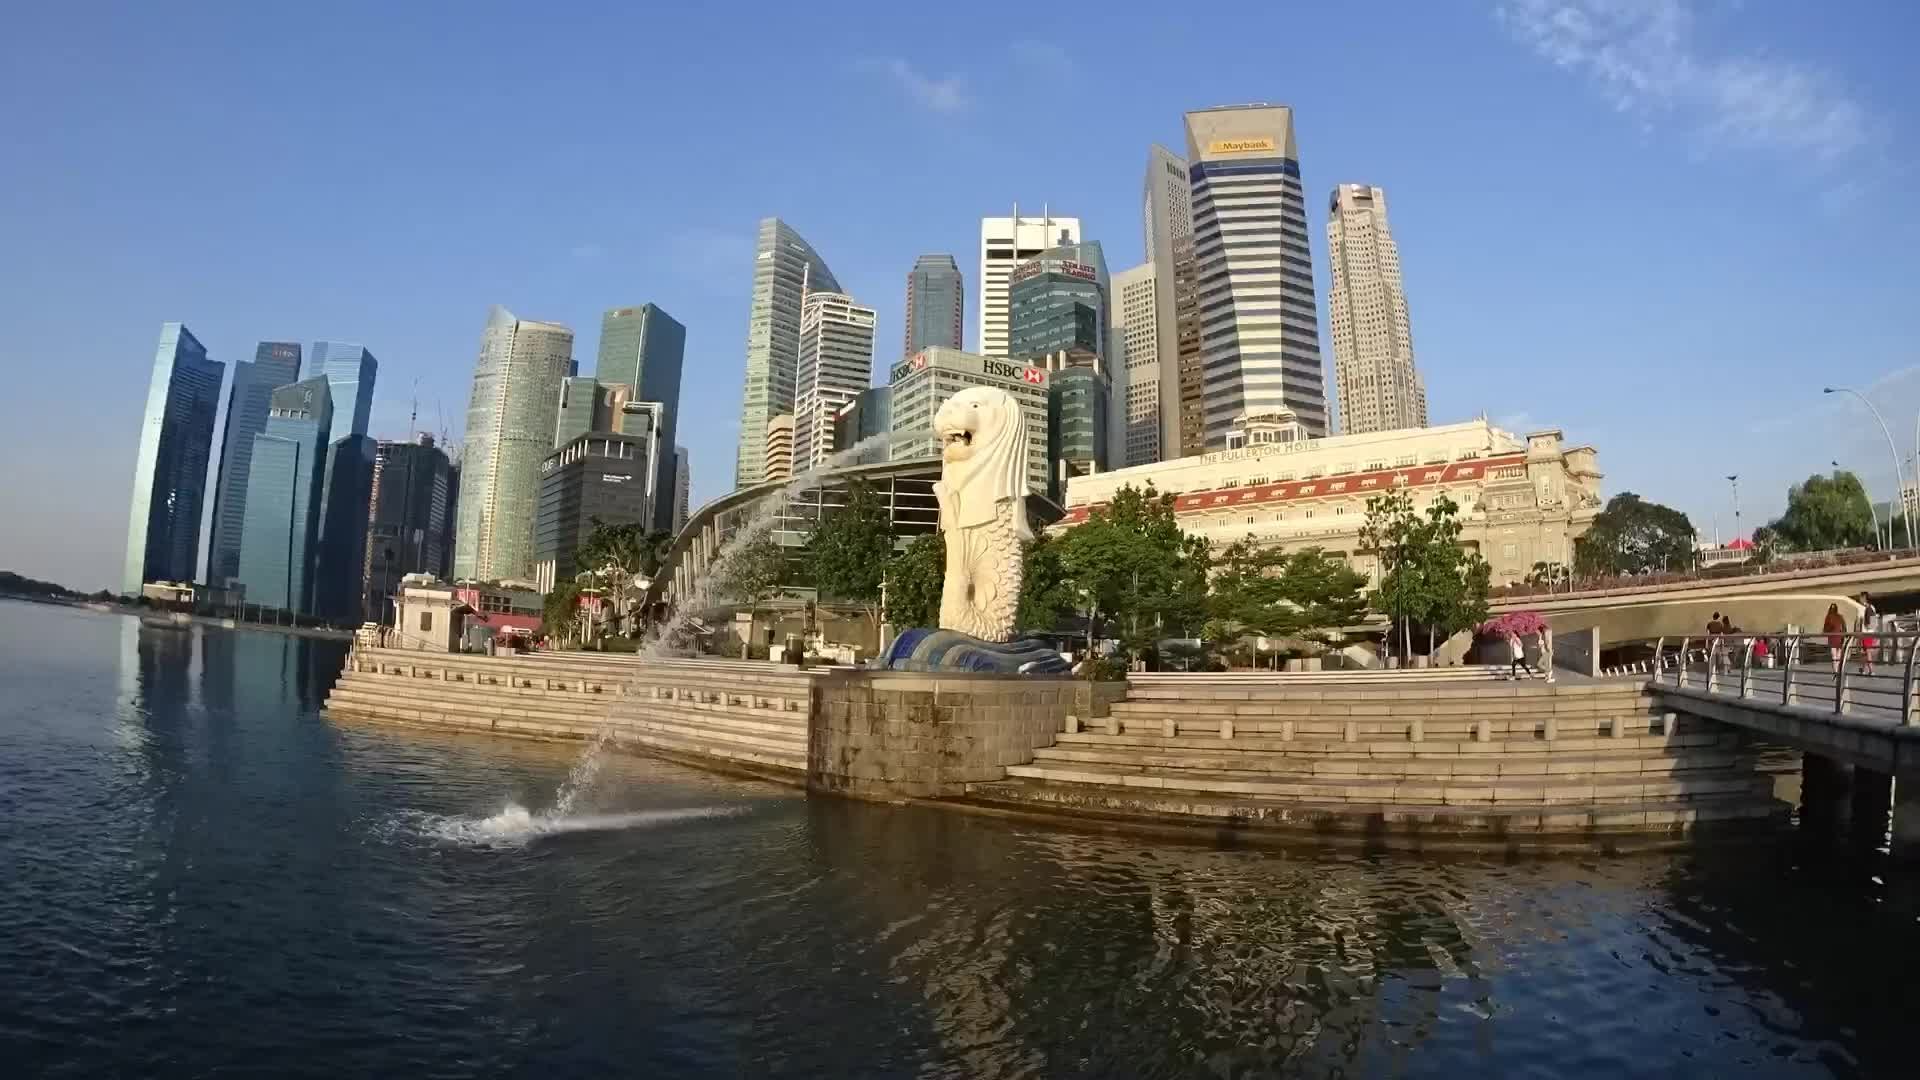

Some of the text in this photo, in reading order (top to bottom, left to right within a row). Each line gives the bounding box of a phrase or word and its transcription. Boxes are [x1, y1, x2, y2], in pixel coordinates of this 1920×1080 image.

[1223, 140, 1268, 150] Maybank
[891, 360, 914, 383] HSBC
[983, 359, 1023, 379] HSBC
[1200, 454, 1217, 465] THE
[1285, 439, 1319, 453] HOTEL
